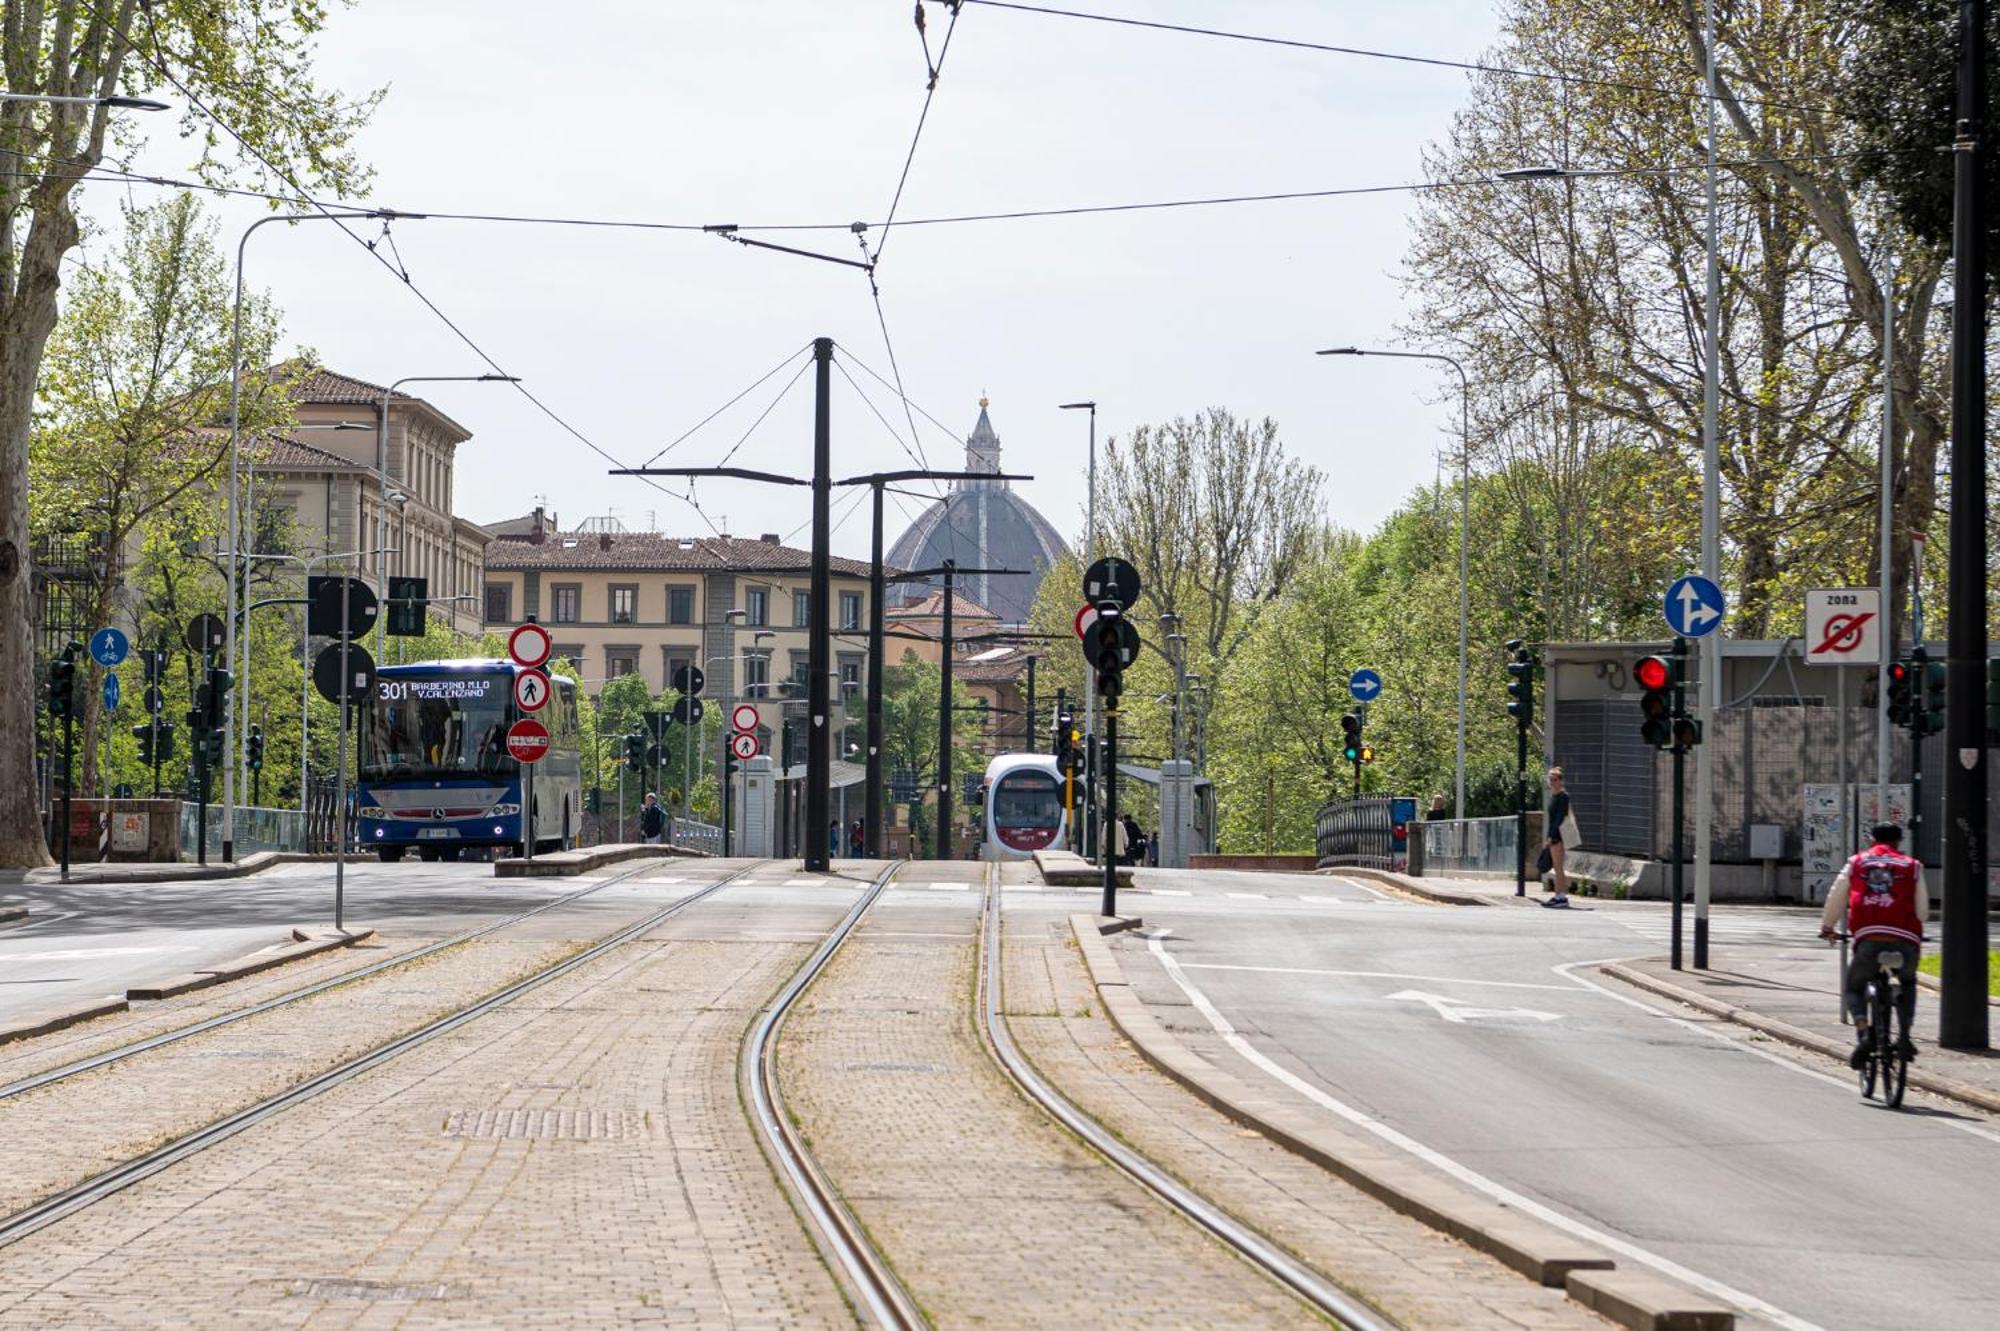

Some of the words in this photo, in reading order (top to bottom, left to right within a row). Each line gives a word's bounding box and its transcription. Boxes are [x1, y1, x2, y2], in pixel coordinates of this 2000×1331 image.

[1827, 595, 1858, 605] zona
[379, 682, 408, 700] 301
[411, 681, 465, 691] BARBERINO
